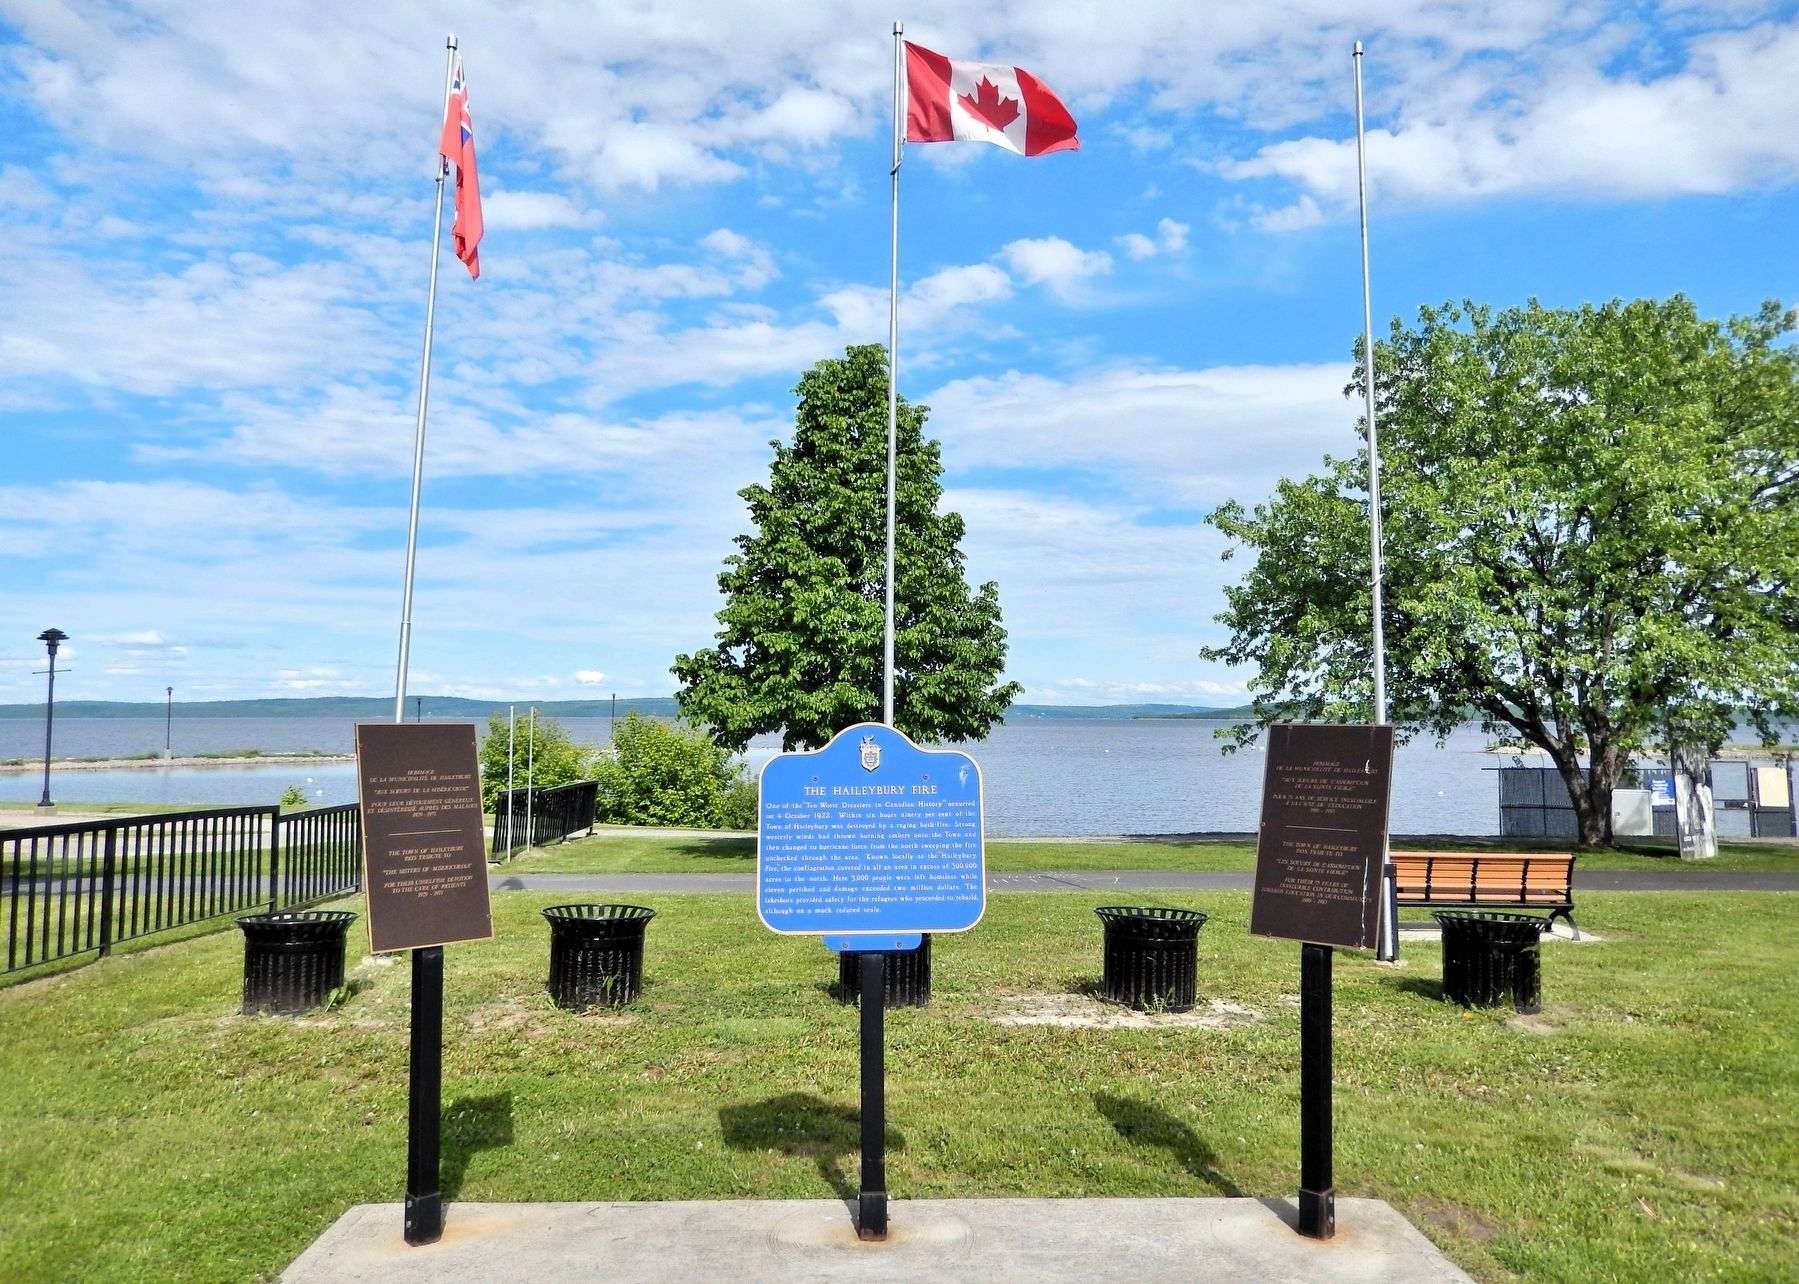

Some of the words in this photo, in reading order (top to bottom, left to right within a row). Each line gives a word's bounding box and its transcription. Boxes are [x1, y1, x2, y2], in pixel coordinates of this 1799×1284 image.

[804, 786, 826, 796] THE
[833, 785, 904, 796] HAILEYBURY
[912, 785, 937, 795] FIRE
